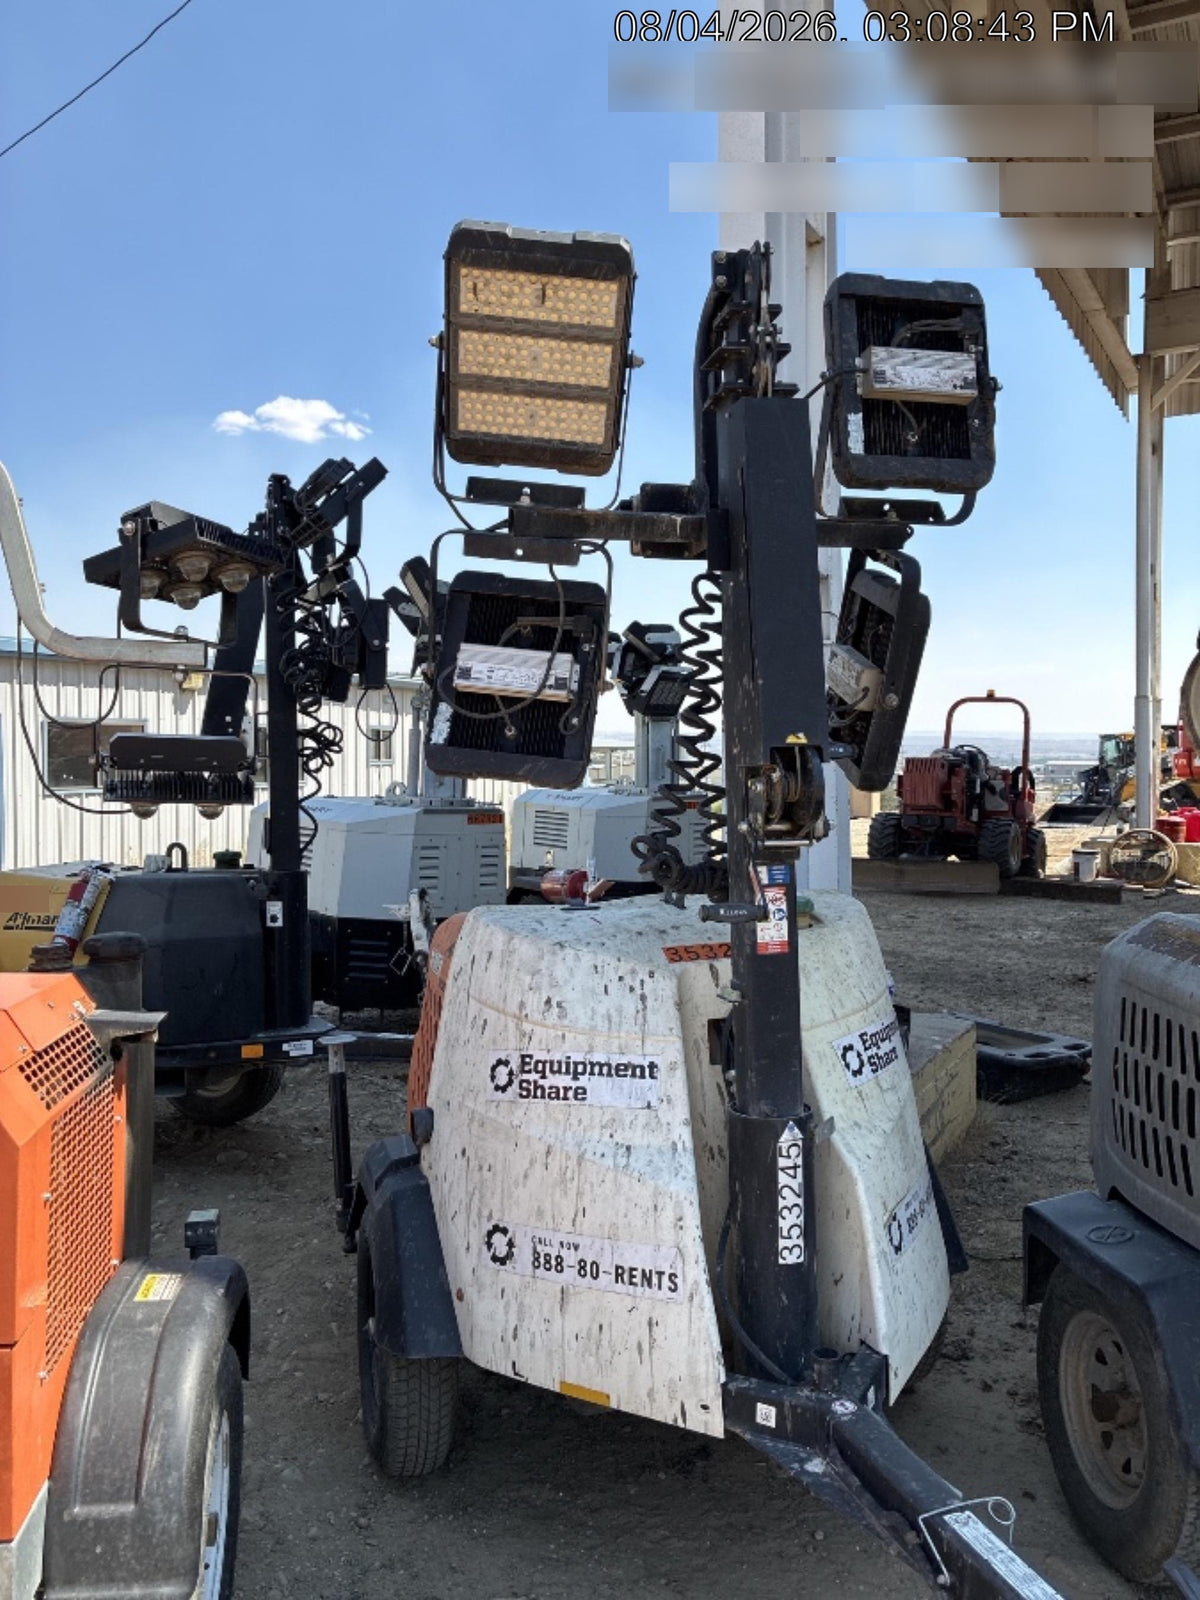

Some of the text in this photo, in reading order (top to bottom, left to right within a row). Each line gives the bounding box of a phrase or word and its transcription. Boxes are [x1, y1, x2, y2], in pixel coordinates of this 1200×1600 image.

[666, 943, 731, 962] 3532
[519, 1054, 659, 1082] Equipment
[518, 1079, 588, 1101] Share
[778, 1142, 803, 1261] 353245
[531, 1235, 580, 1252] CALL NOW
[531, 1250, 679, 1293] 888-80-RENTS
